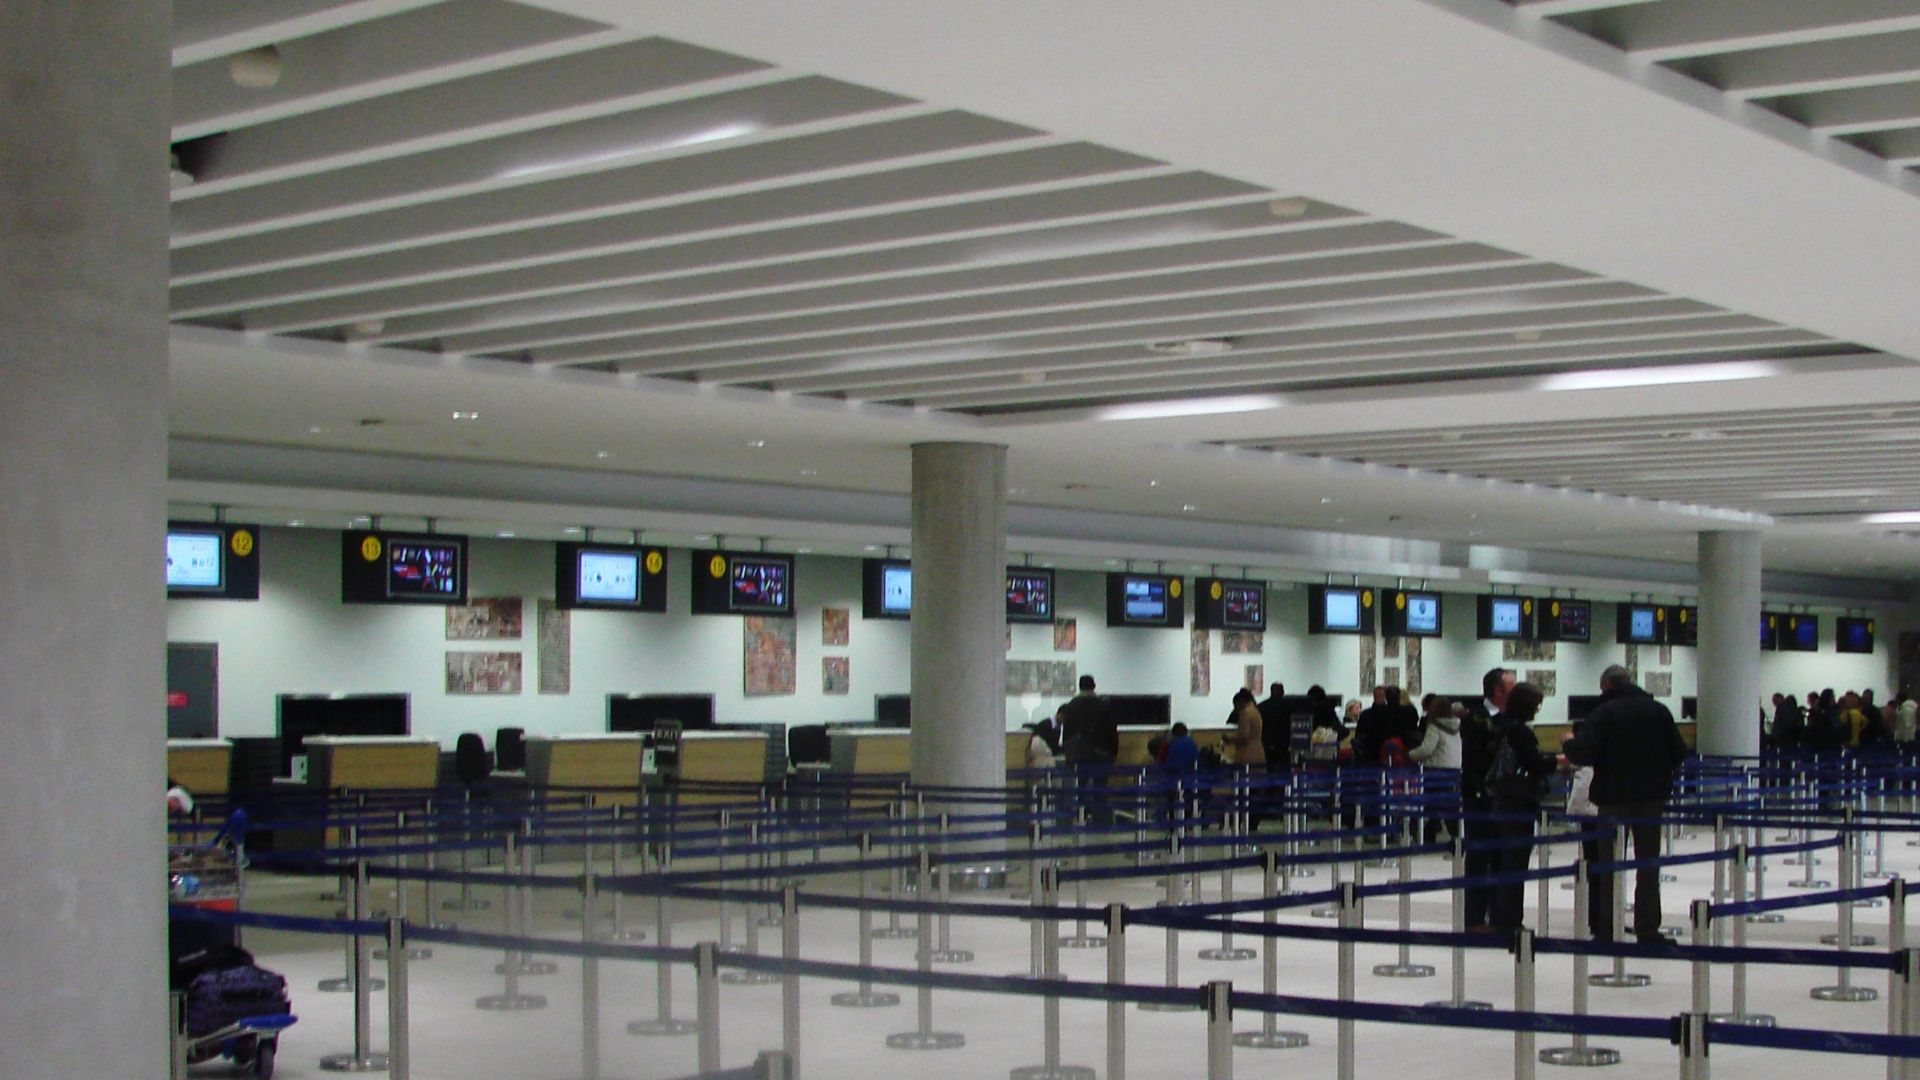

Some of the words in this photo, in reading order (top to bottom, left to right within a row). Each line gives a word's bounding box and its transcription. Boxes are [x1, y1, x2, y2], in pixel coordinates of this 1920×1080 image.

[235, 536, 250, 551] 12
[366, 543, 379, 555] 13
[657, 729, 680, 739] EXIT
